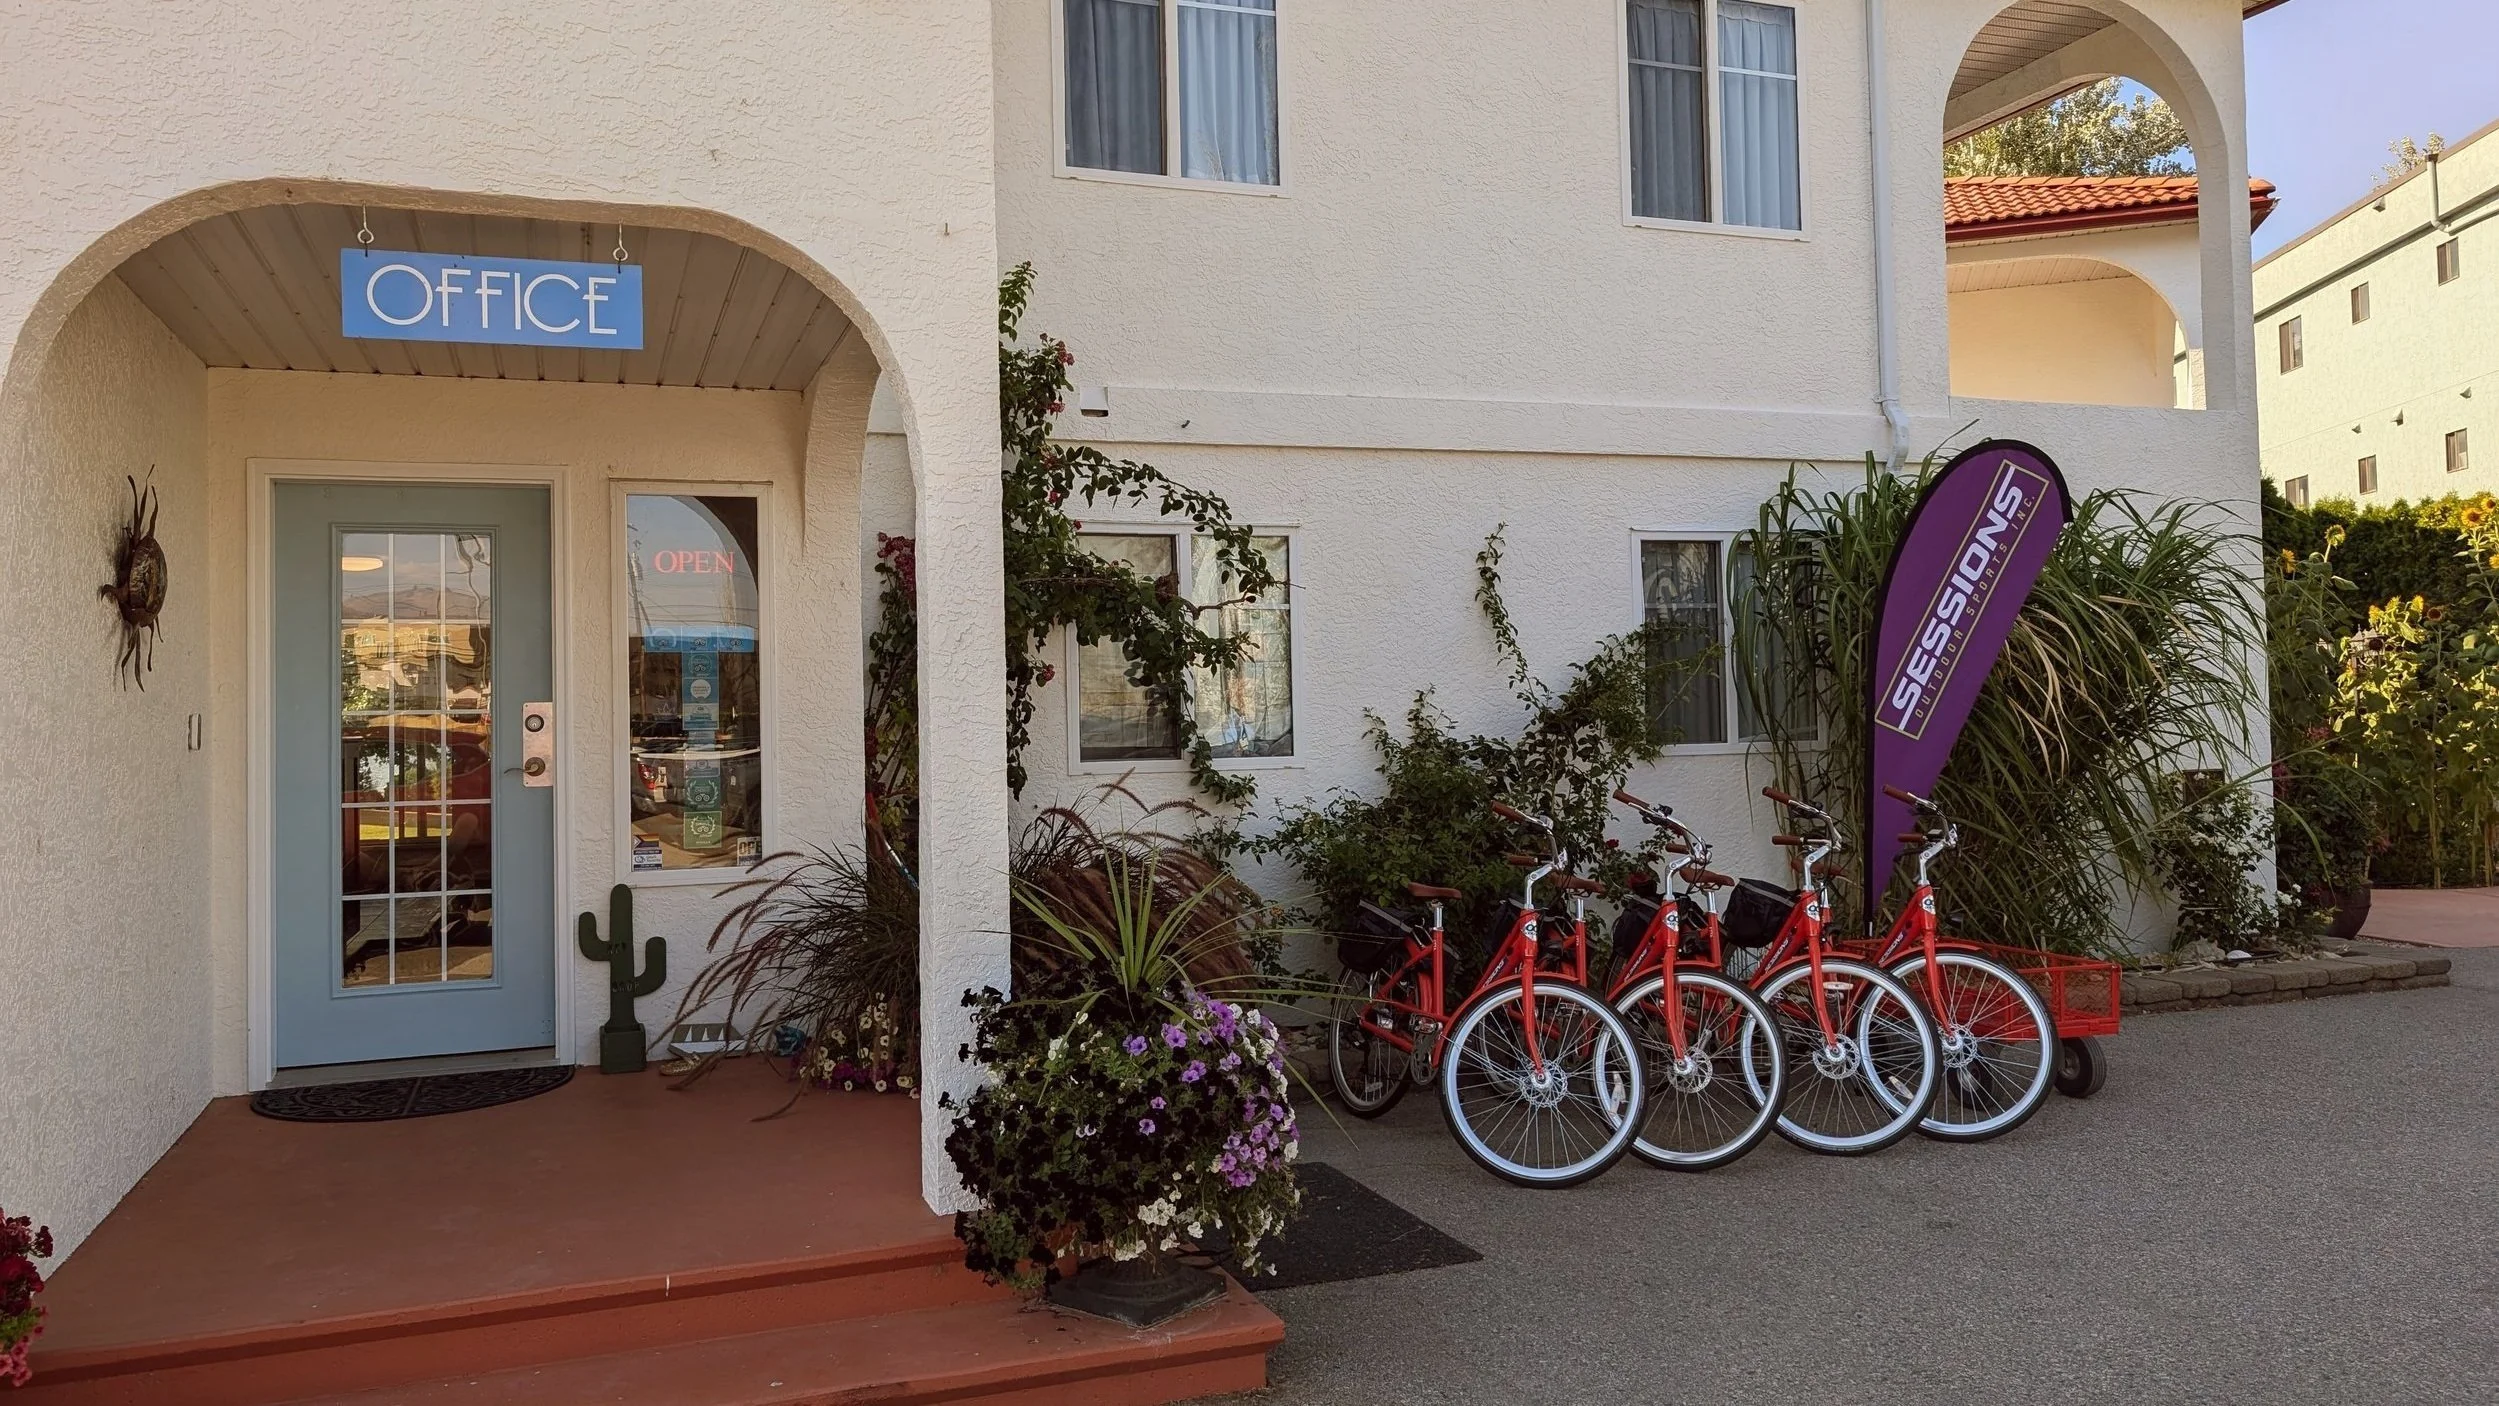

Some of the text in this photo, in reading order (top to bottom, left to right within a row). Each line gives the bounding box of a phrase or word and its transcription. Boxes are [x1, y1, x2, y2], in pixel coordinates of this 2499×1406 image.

[366, 264, 617, 335] OFFICE
[653, 549, 735, 575] OPEN
[1892, 465, 2024, 731] SESSIONS
[1914, 495, 2036, 719] OUTDOOR SPORTS INC.
